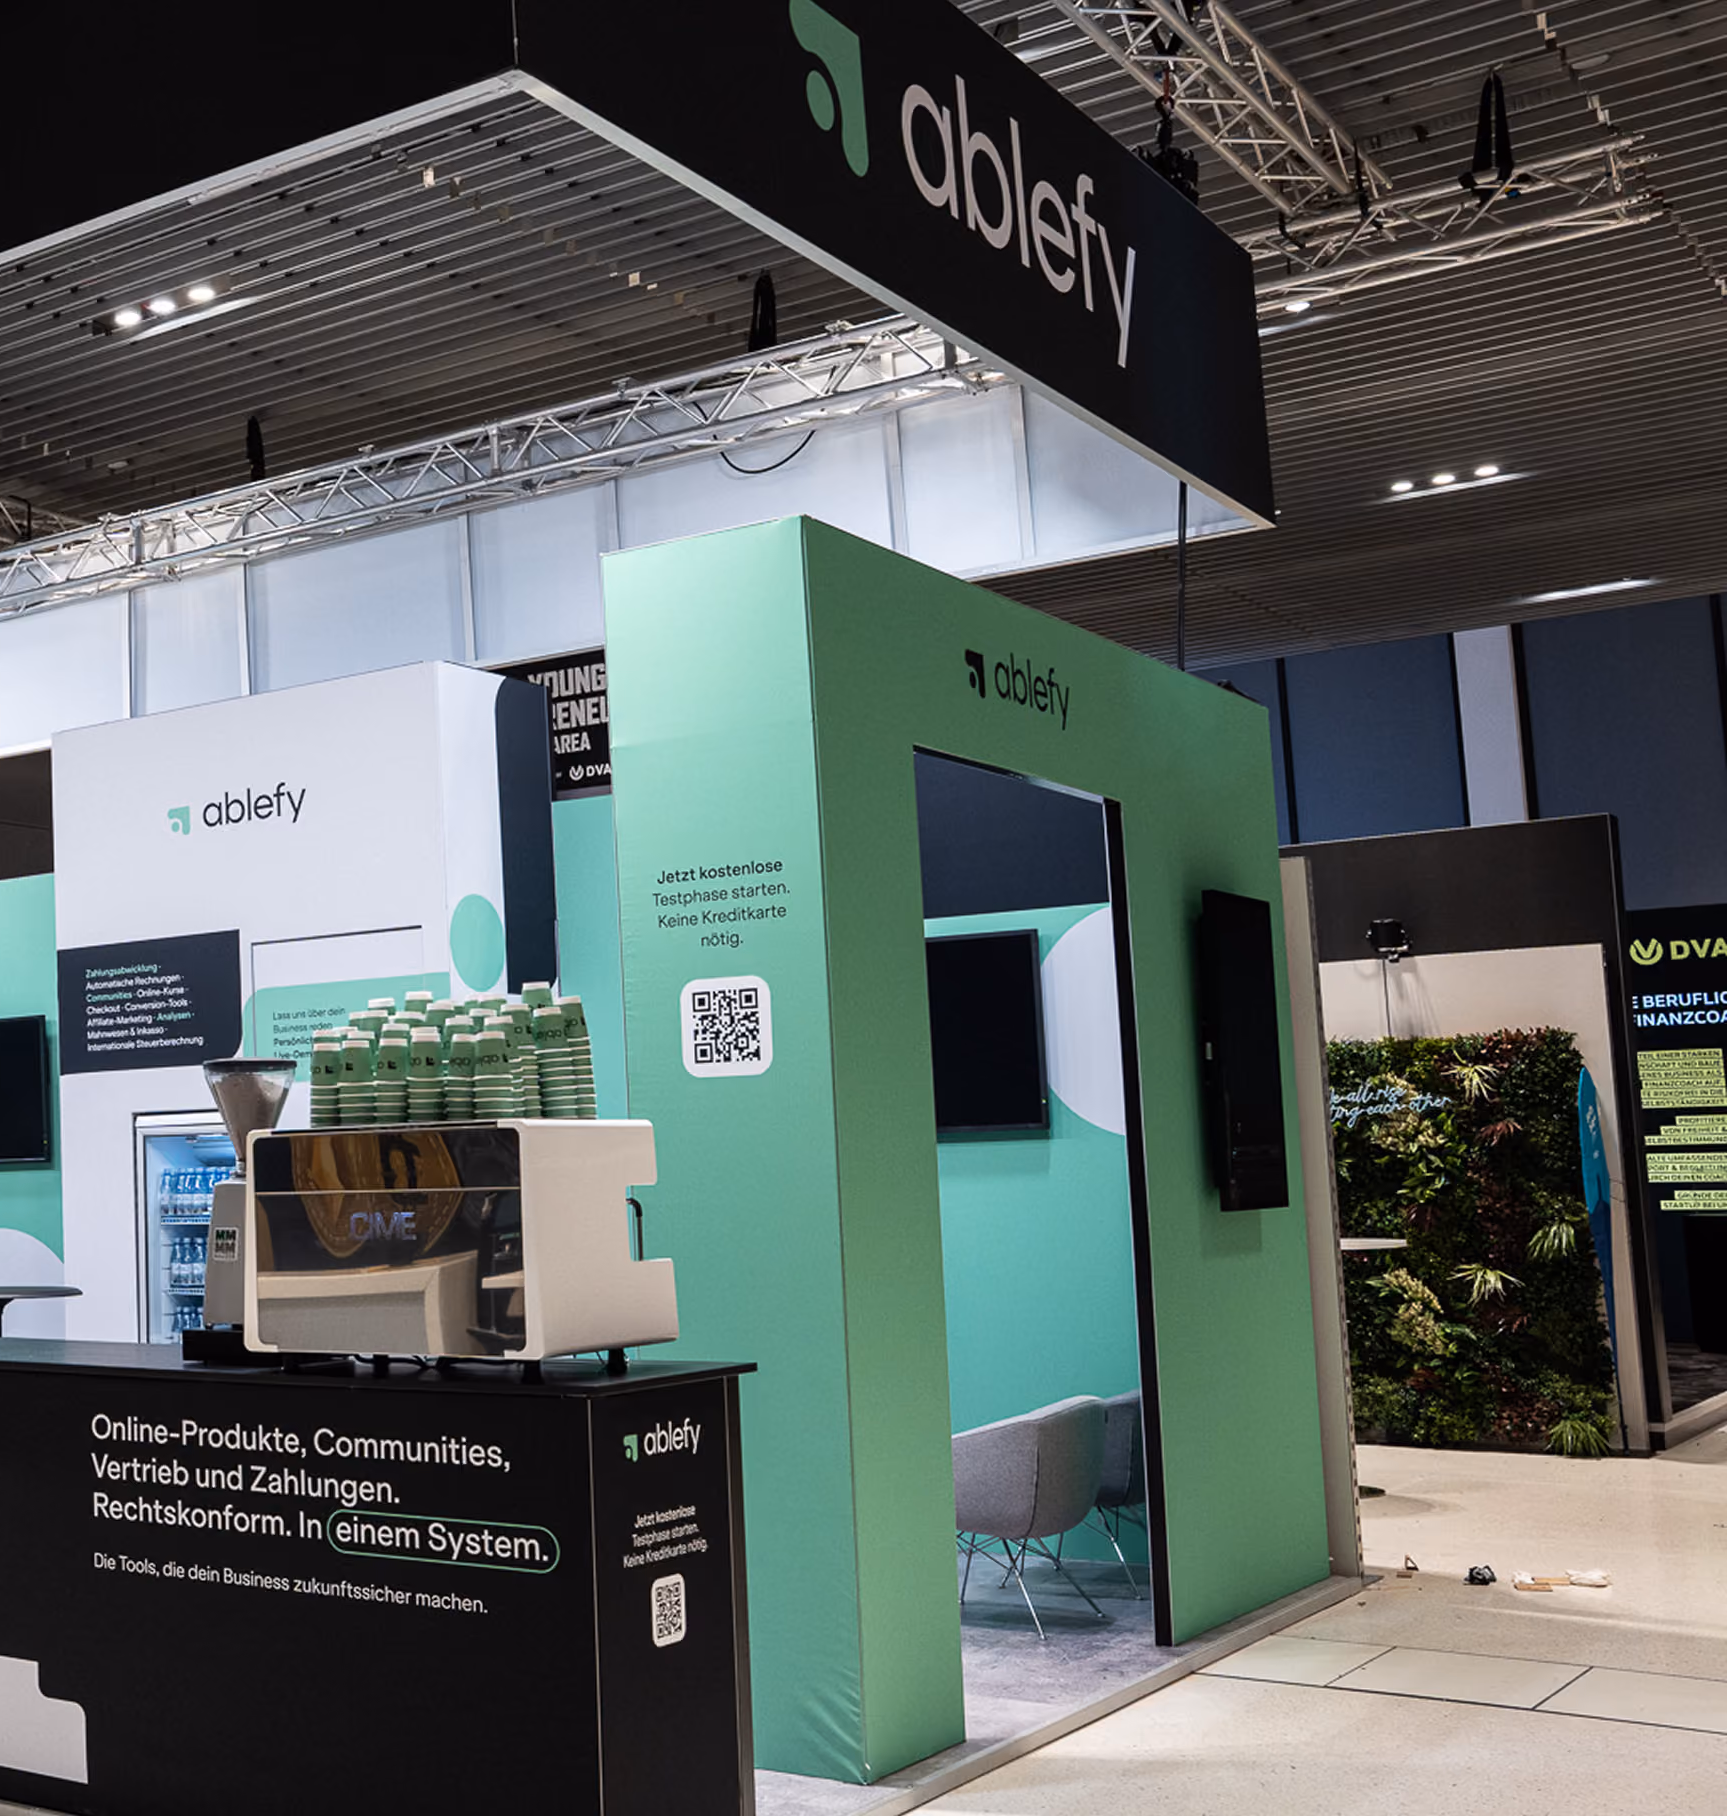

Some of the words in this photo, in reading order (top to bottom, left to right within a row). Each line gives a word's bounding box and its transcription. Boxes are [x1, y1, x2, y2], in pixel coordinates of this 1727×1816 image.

[901, 74, 1136, 368] ablefy
[995, 652, 1070, 731] ablefy
[552, 696, 610, 730] ENE
[203, 782, 306, 827] ablefy
[657, 870, 696, 884] Jetzt
[699, 860, 783, 880] kostenlose
[653, 888, 728, 907] Testphase
[731, 883, 790, 900] starten.
[658, 913, 698, 928] Keine
[702, 905, 787, 925] Kreditkarte
[701, 931, 744, 948] nötig.
[85, 978, 134, 991] Automatische
[134, 974, 181, 985] Rechnungen
[86, 991, 133, 1003] Communities
[136, 986, 185, 998] Online-Kurse
[86, 1004, 121, 1015] Checkout
[124, 998, 188, 1011] Conversion-Tools
[156, 1011, 192, 1021] Analysen
[273, 1011, 291, 1021] Lass
[291, 1010, 306, 1020] uns
[307, 1008, 326, 1018] über
[327, 1006, 346, 1016] dein
[87, 1029, 129, 1040] Mahnwesen
[129, 1028, 136, 1036] &
[136, 1026, 165, 1035] Inkasso
[273, 1024, 308, 1034] Business
[309, 1021, 333, 1031] reden
[87, 1041, 135, 1051] Internationale
[136, 1036, 204, 1048] Steuerberechnung
[91, 1413, 307, 1458] Online-Produkte,
[314, 1428, 511, 1472] Communities,
[644, 1417, 701, 1456] ablefy
[91, 1453, 189, 1487] Vertrieb
[196, 1464, 243, 1491] und
[250, 1465, 400, 1508] Zahlungen.
[93, 1491, 292, 1537] Rechtskonform.
[299, 1511, 322, 1540] In
[335, 1516, 420, 1549] einem
[428, 1522, 549, 1562] System.
[634, 1514, 655, 1528] Jetzt
[655, 1505, 696, 1523] kostenlose
[632, 1530, 671, 1547] Testphase
[623, 1552, 645, 1568] Keine
[645, 1543, 688, 1563] Kreditkarte
[94, 1552, 116, 1570] Die
[119, 1555, 160, 1577] Tools,
[162, 1561, 185, 1578] die
[188, 1564, 220, 1583] dein
[224, 1567, 290, 1591] Business
[293, 1577, 412, 1605] zukunftssicher
[416, 1593, 488, 1614] machen.
